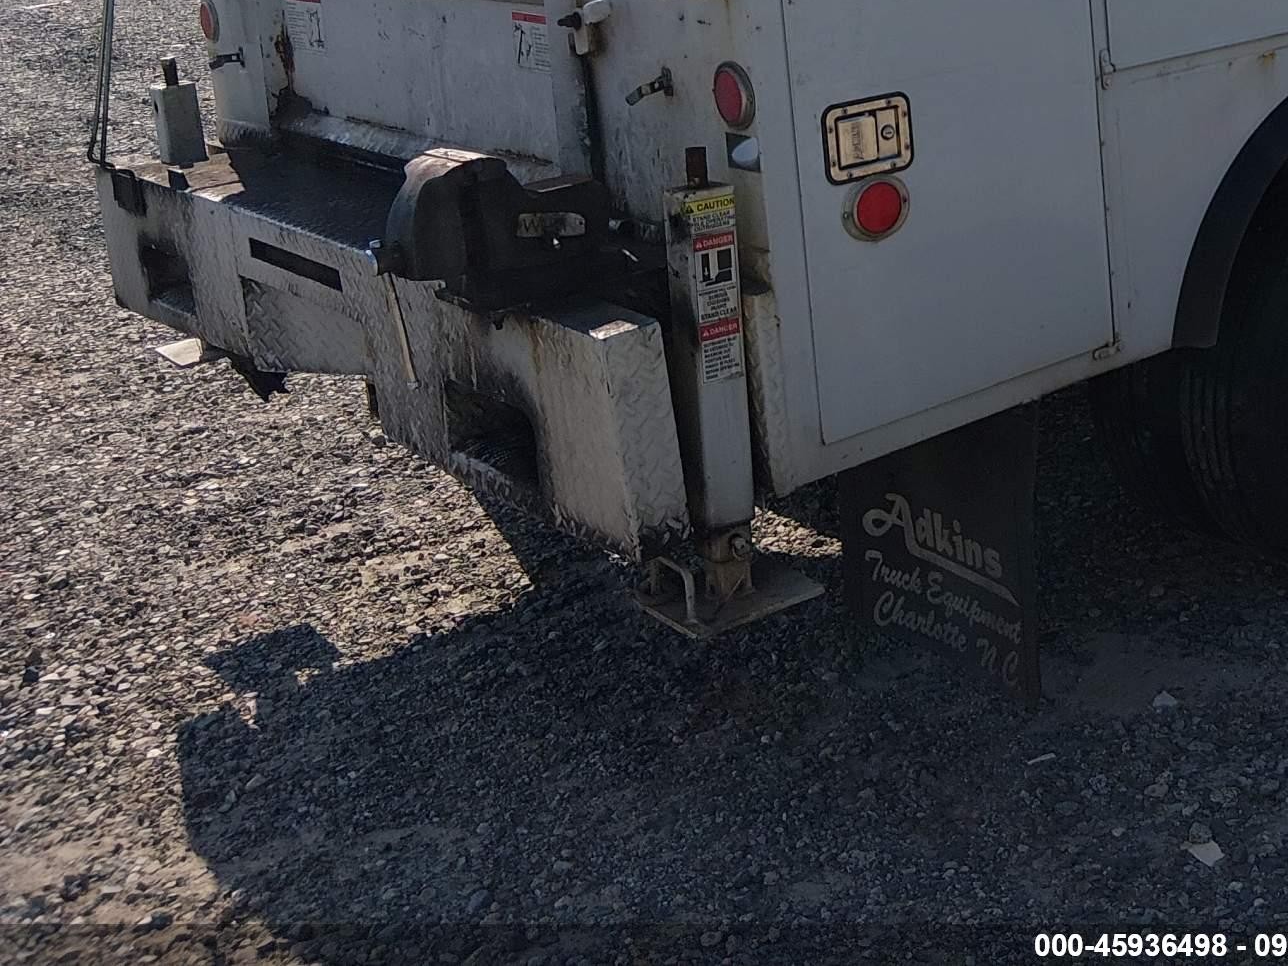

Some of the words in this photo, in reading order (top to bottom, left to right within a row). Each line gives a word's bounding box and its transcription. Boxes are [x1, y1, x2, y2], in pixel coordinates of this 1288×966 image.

[697, 197, 735, 212] CAUTION
[702, 233, 733, 248] DANGER
[709, 322, 738, 334] DANGER
[862, 492, 1003, 580] Adkins
[865, 549, 923, 595] Truck
[926, 571, 1023, 645] Equipment
[873, 590, 968, 653] Charlotte
